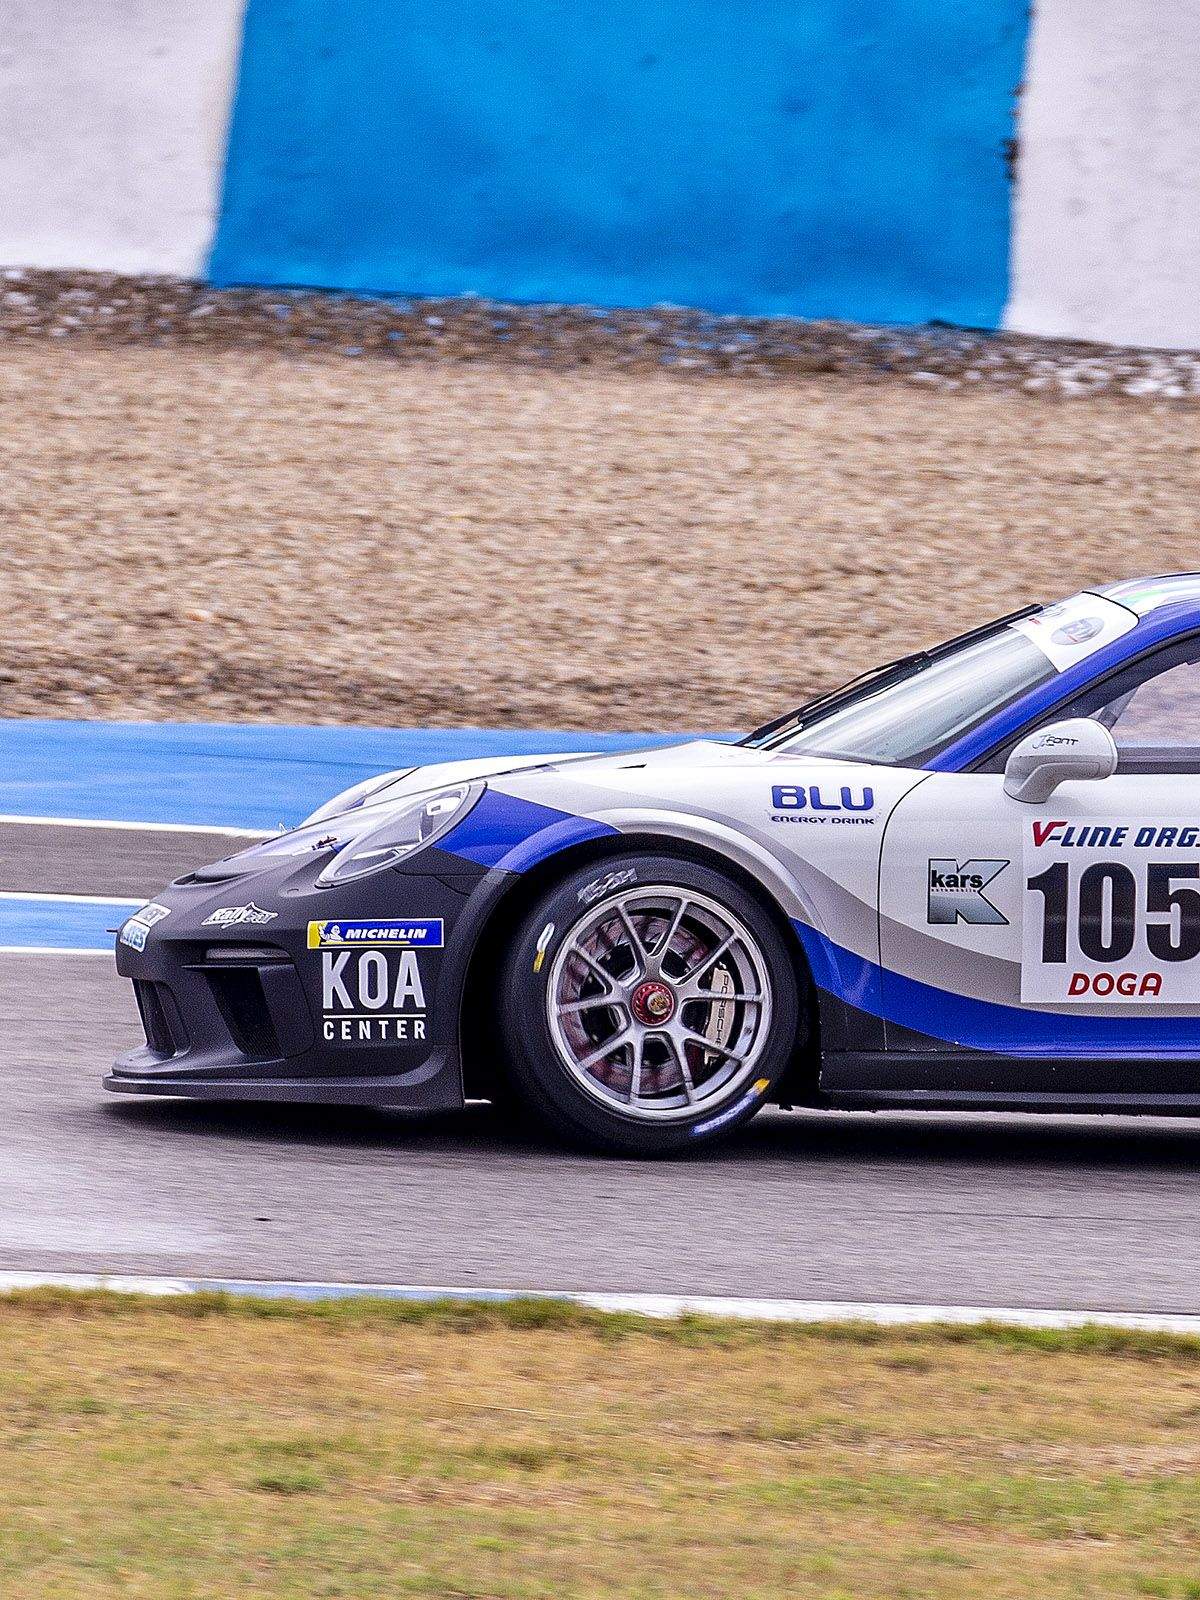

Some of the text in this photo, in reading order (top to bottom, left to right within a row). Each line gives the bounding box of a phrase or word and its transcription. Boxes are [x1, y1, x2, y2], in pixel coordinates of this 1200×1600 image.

[771, 785, 875, 811] BLU
[771, 815, 875, 825] ENERGY DRINK
[1032, 821, 1129, 848] V-LINE
[931, 870, 983, 888] kars
[345, 929, 428, 939] MICHELIN
[322, 950, 427, 1009] KOA
[1068, 972, 1163, 996] DOGA
[323, 1020, 426, 1040] CENTER
